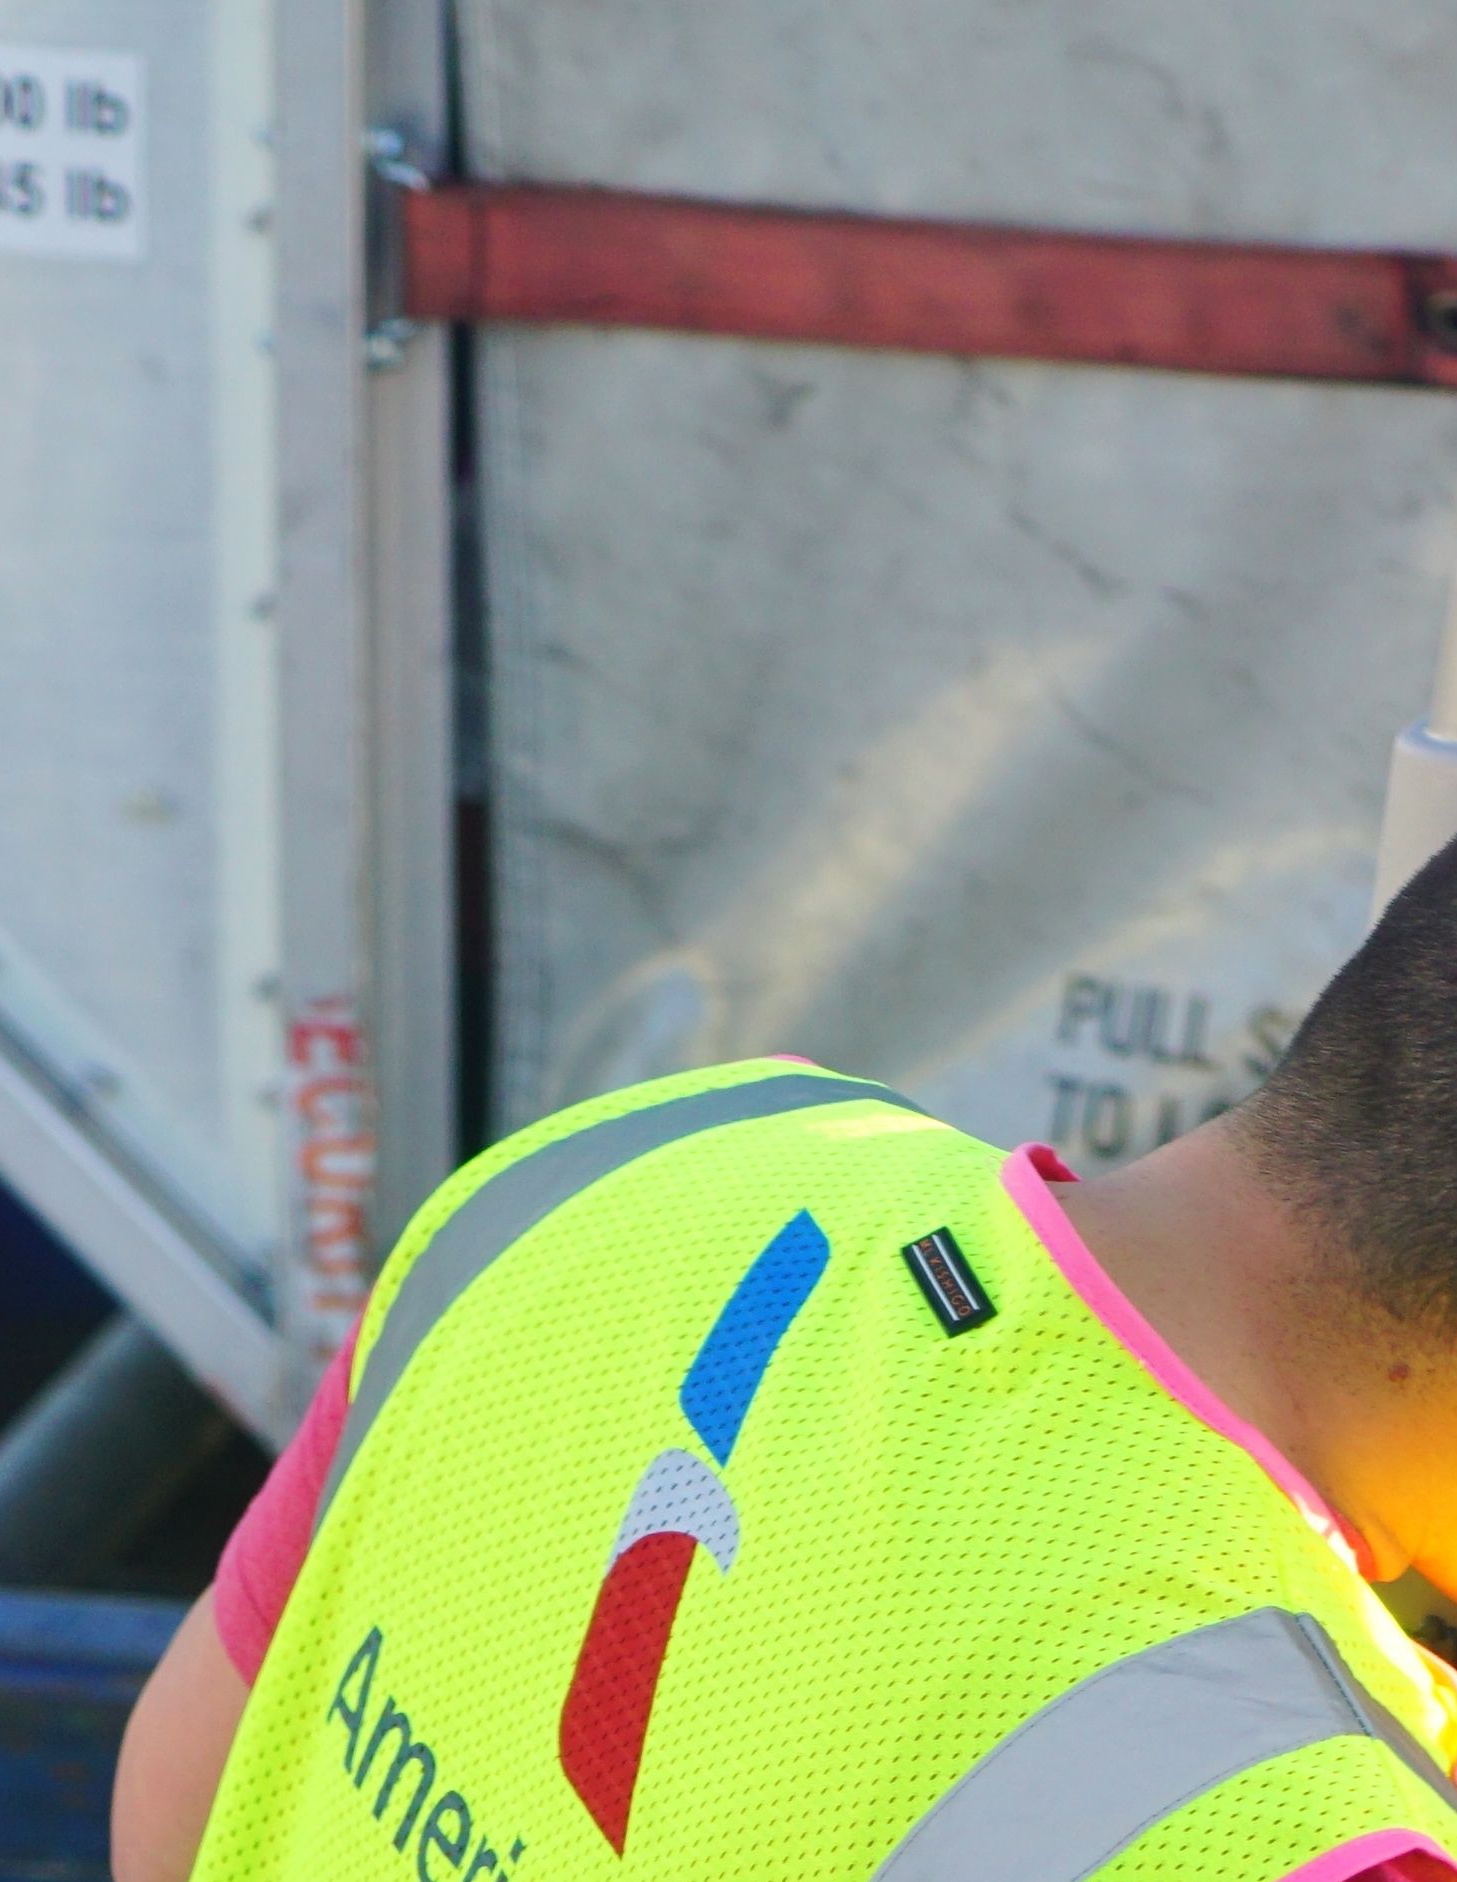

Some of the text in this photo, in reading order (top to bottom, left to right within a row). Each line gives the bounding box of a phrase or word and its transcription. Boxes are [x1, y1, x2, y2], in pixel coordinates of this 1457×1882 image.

[65, 77, 130, 137] lb
[65, 165, 131, 223] lb
[1054, 971, 1222, 1070] PULL
[1046, 1072, 1132, 1159] TO
